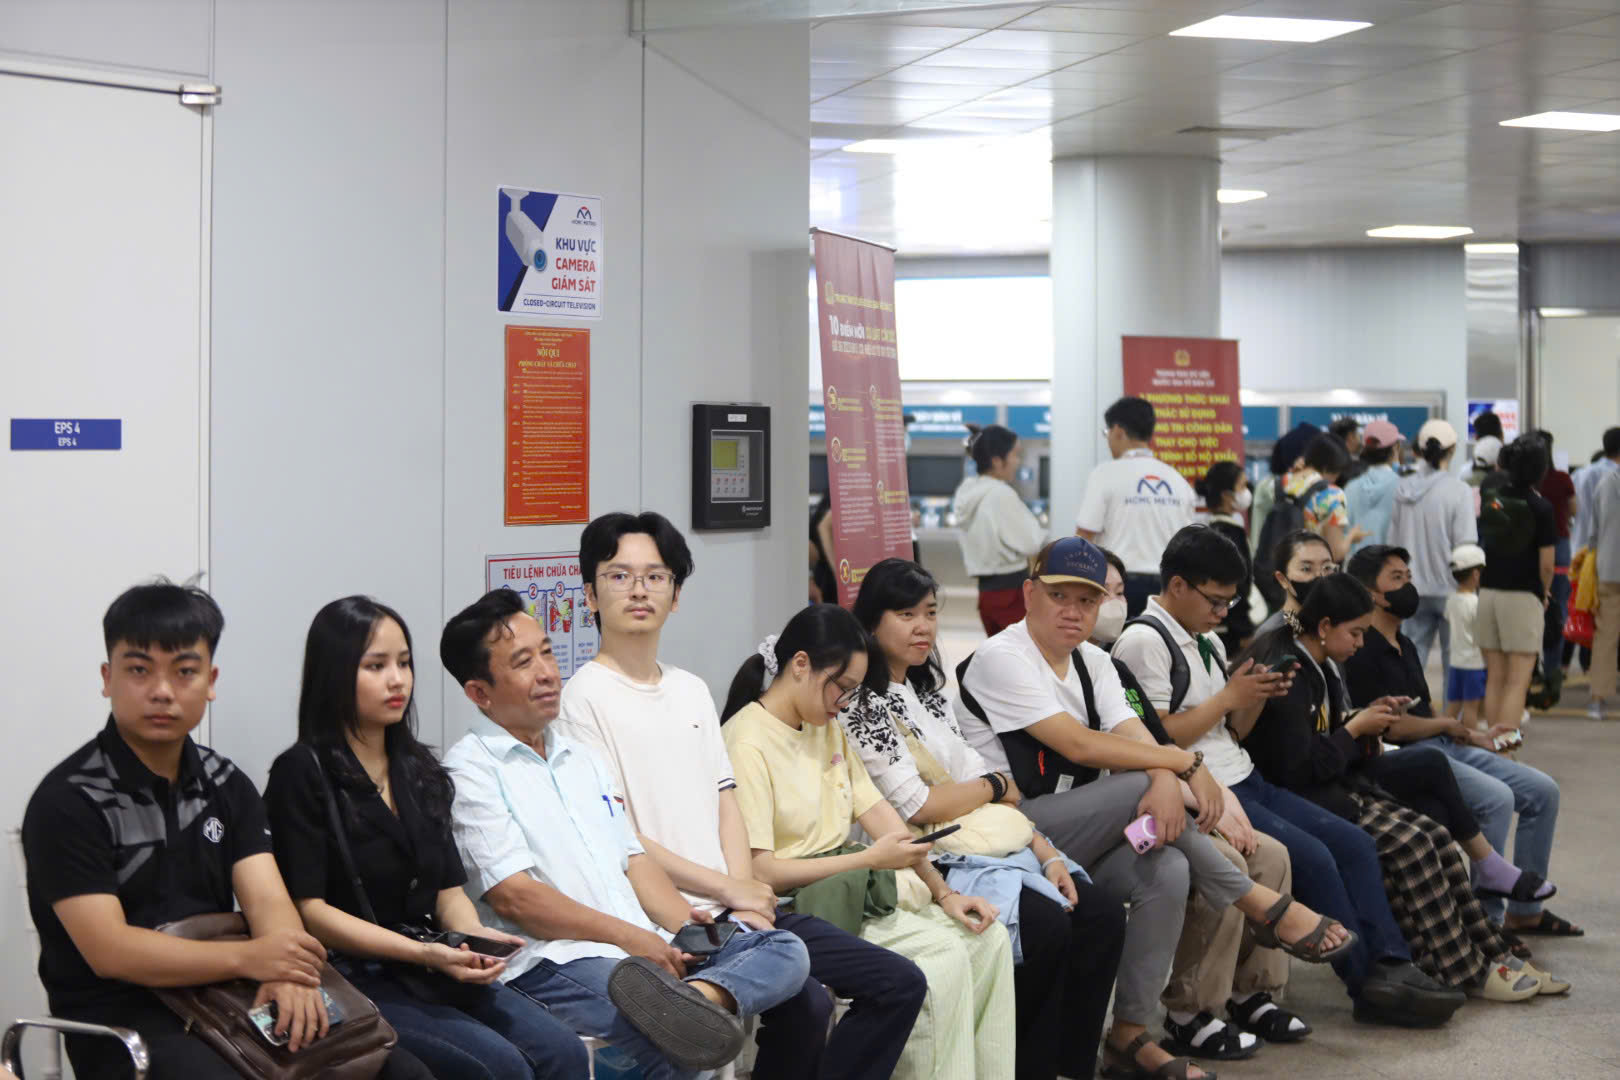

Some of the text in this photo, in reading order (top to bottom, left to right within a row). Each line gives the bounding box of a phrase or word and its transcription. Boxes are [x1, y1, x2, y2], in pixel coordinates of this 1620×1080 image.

[555, 238, 597, 256] KHU VỰC
[555, 257, 596, 272] CAMERA
[551, 274, 597, 293] GIÁM SÁT
[523, 298, 596, 310] CLOSED-CIRCUIT TELEVISION
[54, 421, 80, 434] EPS 4
[58, 437, 77, 446] EPS 4
[568, 565, 583, 576] CH
[531, 583, 563, 596] 2 3
[203, 817, 225, 843] MG
